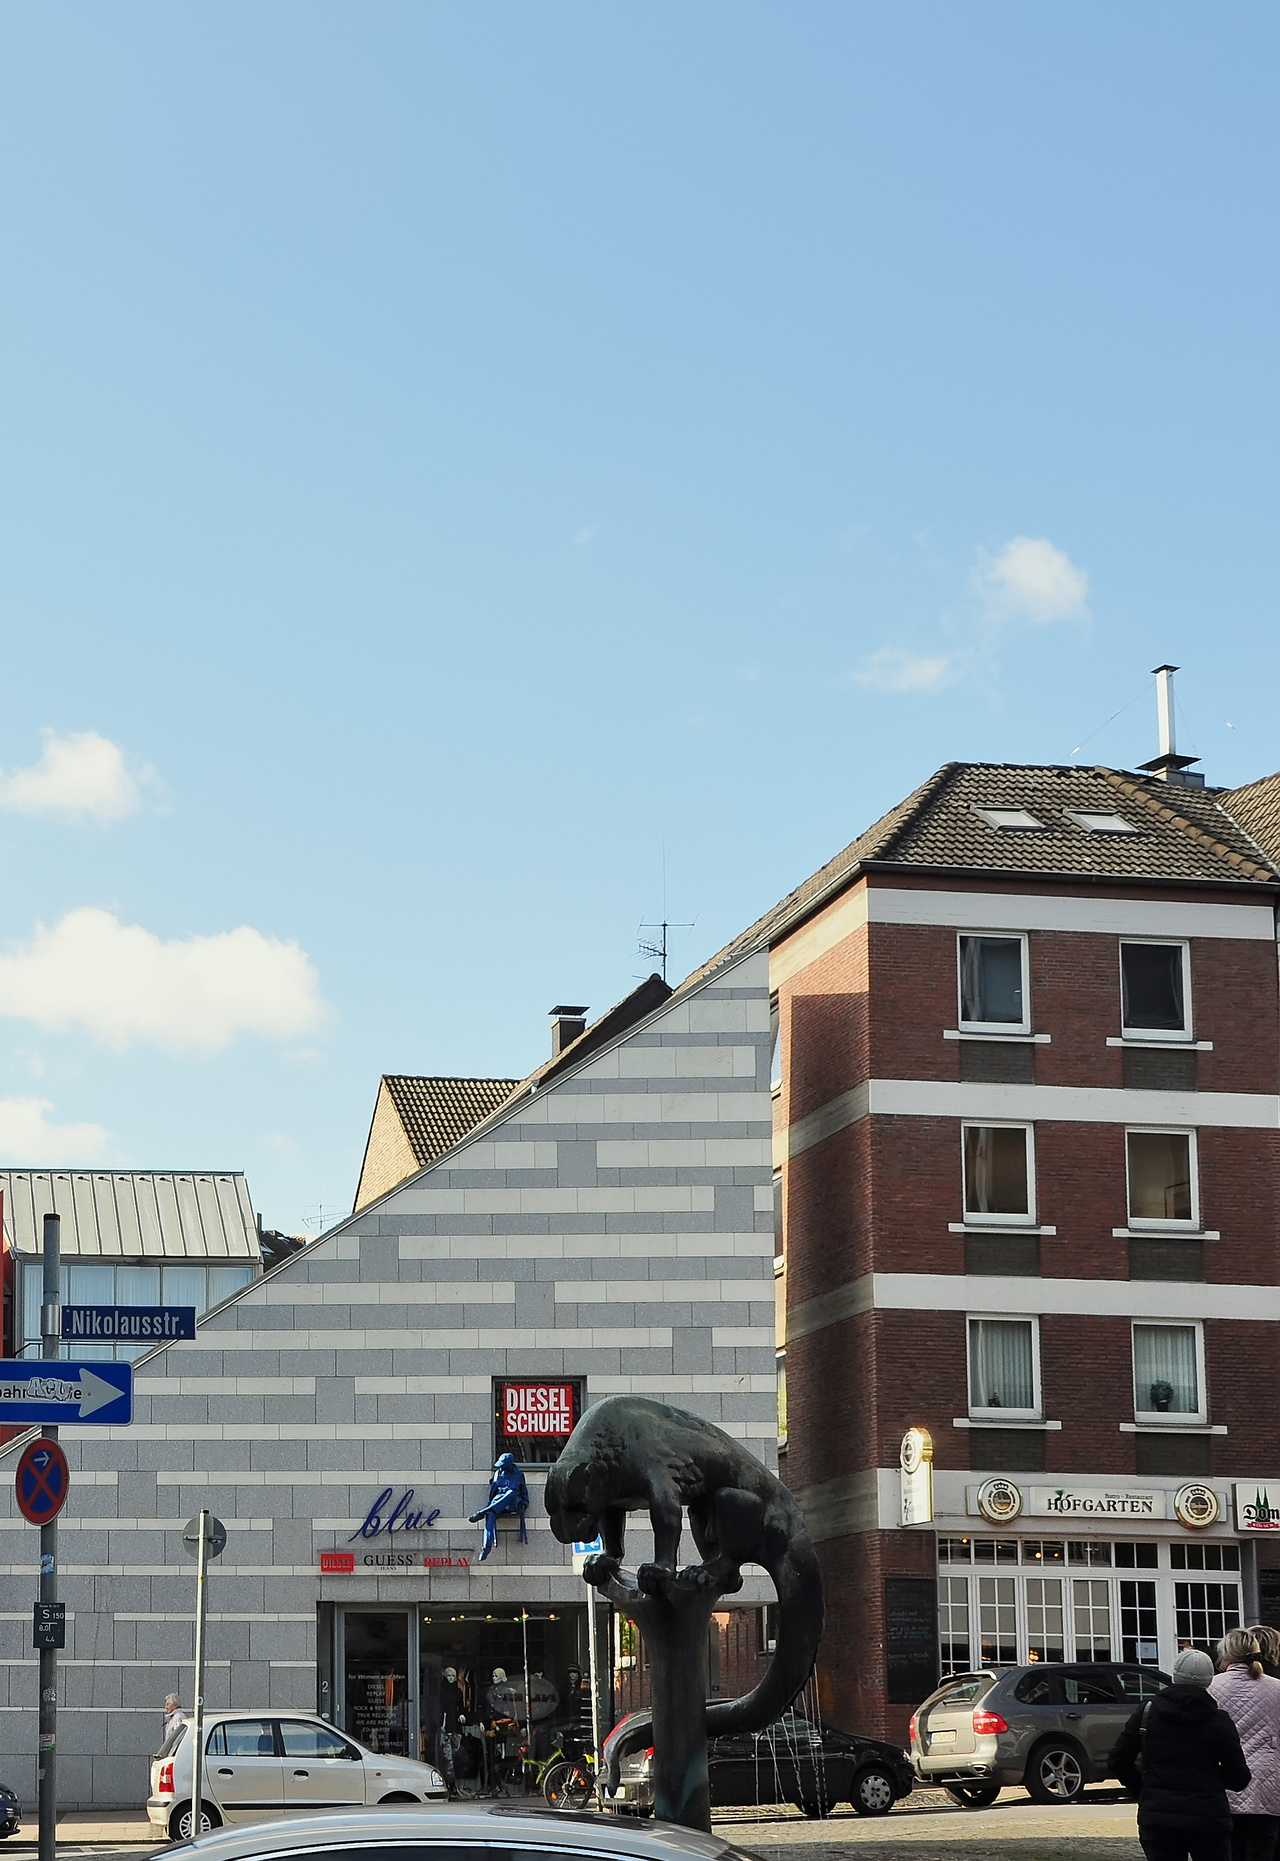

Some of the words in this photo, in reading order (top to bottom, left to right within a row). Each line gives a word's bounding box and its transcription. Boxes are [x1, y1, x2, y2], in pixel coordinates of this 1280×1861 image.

[72, 1310, 185, 1335] Nikolausstr.
[506, 1388, 570, 1411] DIESEL
[506, 1412, 570, 1433] SCHUHE
[1047, 1496, 1153, 1513] HOFGARTEN
[1243, 1504, 1280, 1520] Dom
[347, 1487, 440, 1543] blue
[322, 1557, 351, 1569] DIESEL
[363, 1554, 413, 1566] GUESS
[423, 1557, 470, 1568] REPLAY
[42, 1609, 50, 1619] S
[322, 1680, 329, 1693] 2
